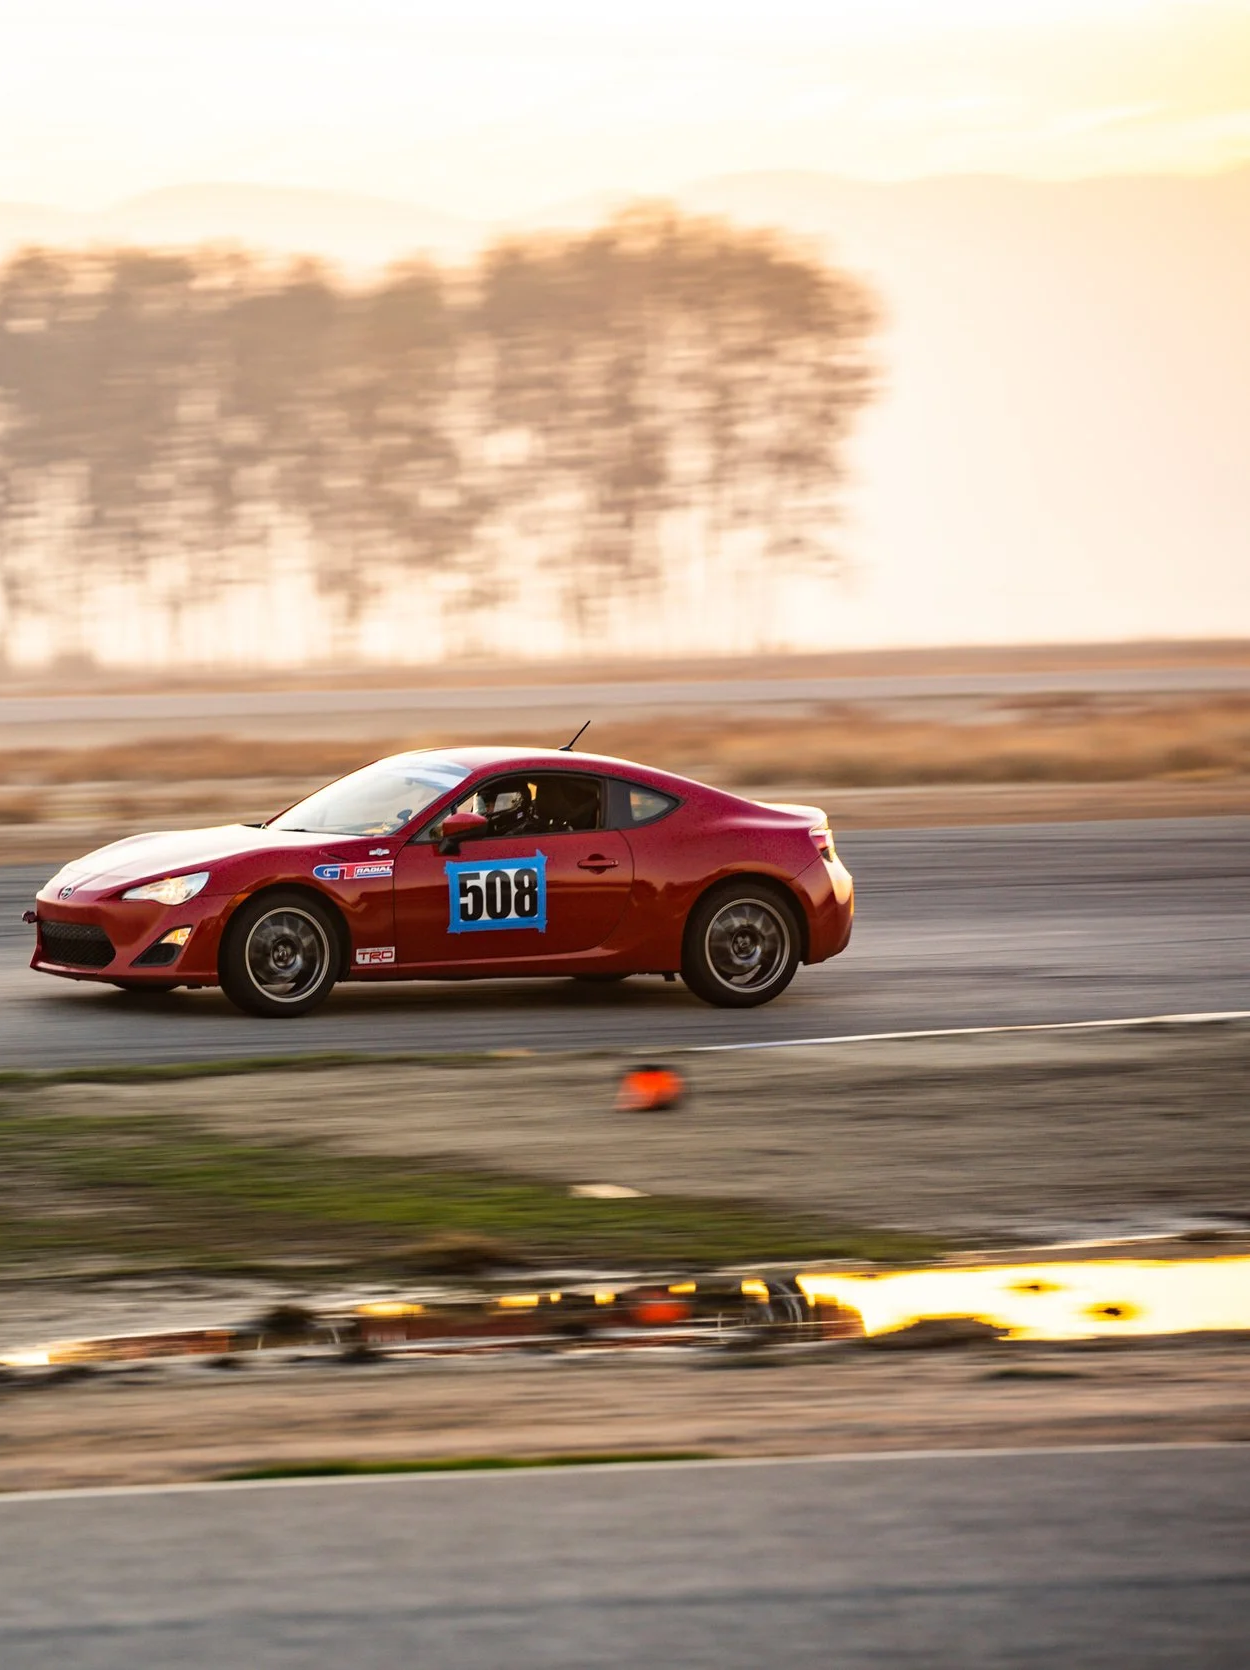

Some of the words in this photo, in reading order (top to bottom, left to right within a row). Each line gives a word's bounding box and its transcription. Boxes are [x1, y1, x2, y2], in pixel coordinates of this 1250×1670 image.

[313, 862, 357, 880] GT
[356, 865, 393, 875] RADIAL
[458, 868, 538, 921] 508
[358, 950, 394, 962] TRD
